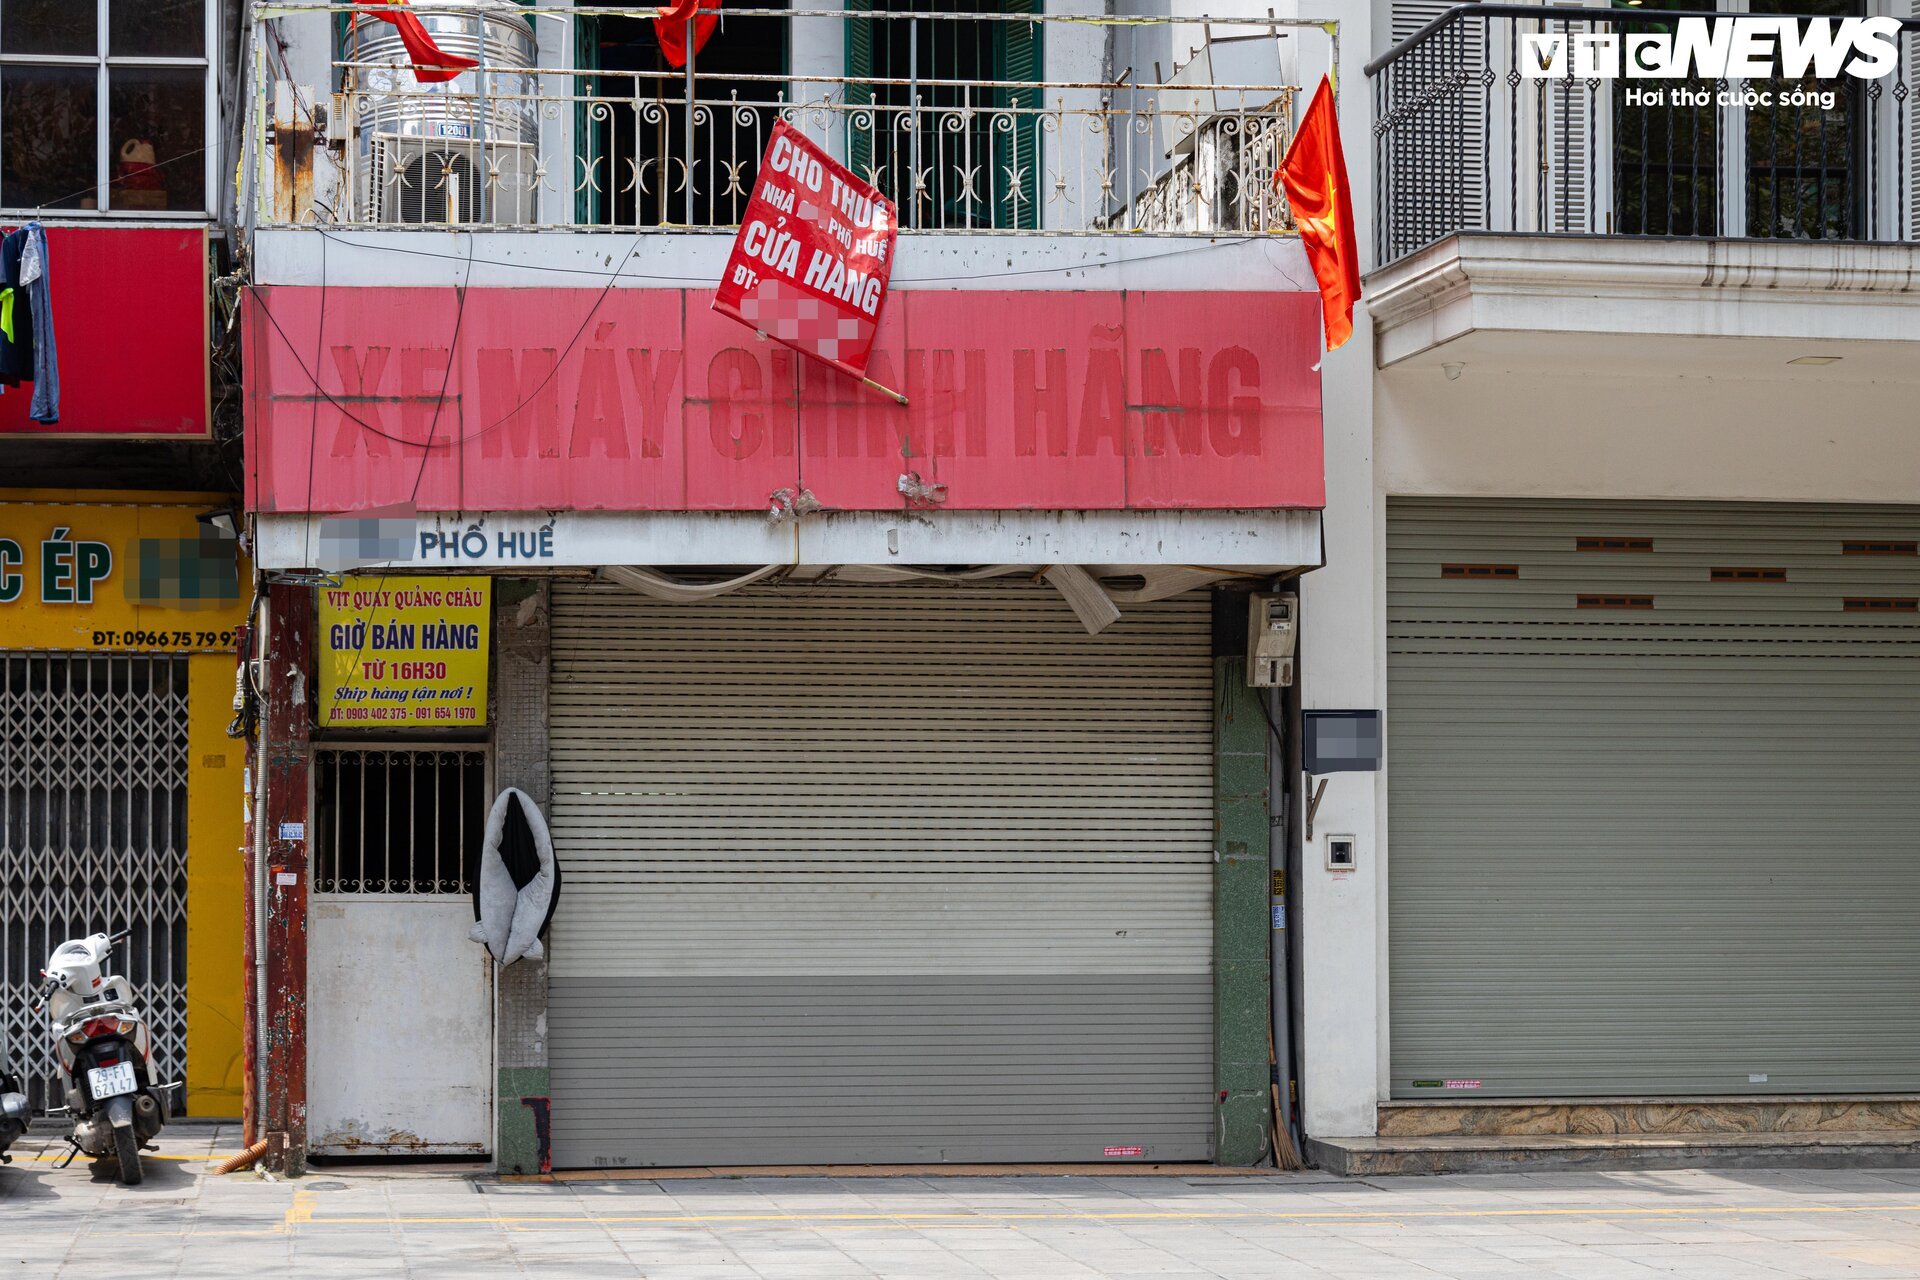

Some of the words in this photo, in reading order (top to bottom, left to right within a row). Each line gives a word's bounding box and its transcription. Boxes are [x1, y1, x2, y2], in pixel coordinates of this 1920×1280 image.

[770, 136, 823, 193] CHO
[830, 174, 889, 231] THUÊ
[761, 181, 795, 214] NHÀ
[828, 217, 853, 250] PHỐ
[855, 238, 889, 263] HUẾ
[732, 264, 759, 290] ĐT:
[743, 216, 802, 279] CỬA
[804, 249, 882, 317] HÀNG
[330, 345, 451, 459] XE
[477, 322, 683, 459] MÁY
[1013, 322, 1263, 458] HÃNG
[420, 518, 488, 559] PHỐ
[498, 518, 556, 559] HUẾ
[41, 527, 113, 604] ÉP
[327, 591, 351, 611] VỊT
[353, 592, 392, 611] QUAY
[395, 585, 442, 611] QUẢNG
[446, 588, 483, 607] CHÂU
[92, 631, 121, 646] ĐT:
[123, 631, 169, 646] 0966
[172, 631, 193, 646] 75
[196, 631, 216, 647] 79
[330, 618, 366, 650] GIỜ
[371, 619, 415, 650] BÁN
[422, 619, 479, 650] HÀNG
[362, 659, 387, 681] TỪ
[390, 661, 447, 681] 16H30
[334, 687, 368, 702] Ship
[371, 686, 409, 702] hàng
[412, 687, 437, 702] tận
[440, 686, 464, 700] nơi
[330, 708, 344, 720] ĐT:
[346, 708, 369, 720] 0903
[371, 708, 388, 720] 402
[390, 708, 407, 720] 375
[415, 708, 431, 719] 091
[435, 708, 451, 719] 654
[454, 708, 476, 719] 1970
[95, 1065, 126, 1083] 29-F1
[95, 1078, 132, 1098] 621.47
